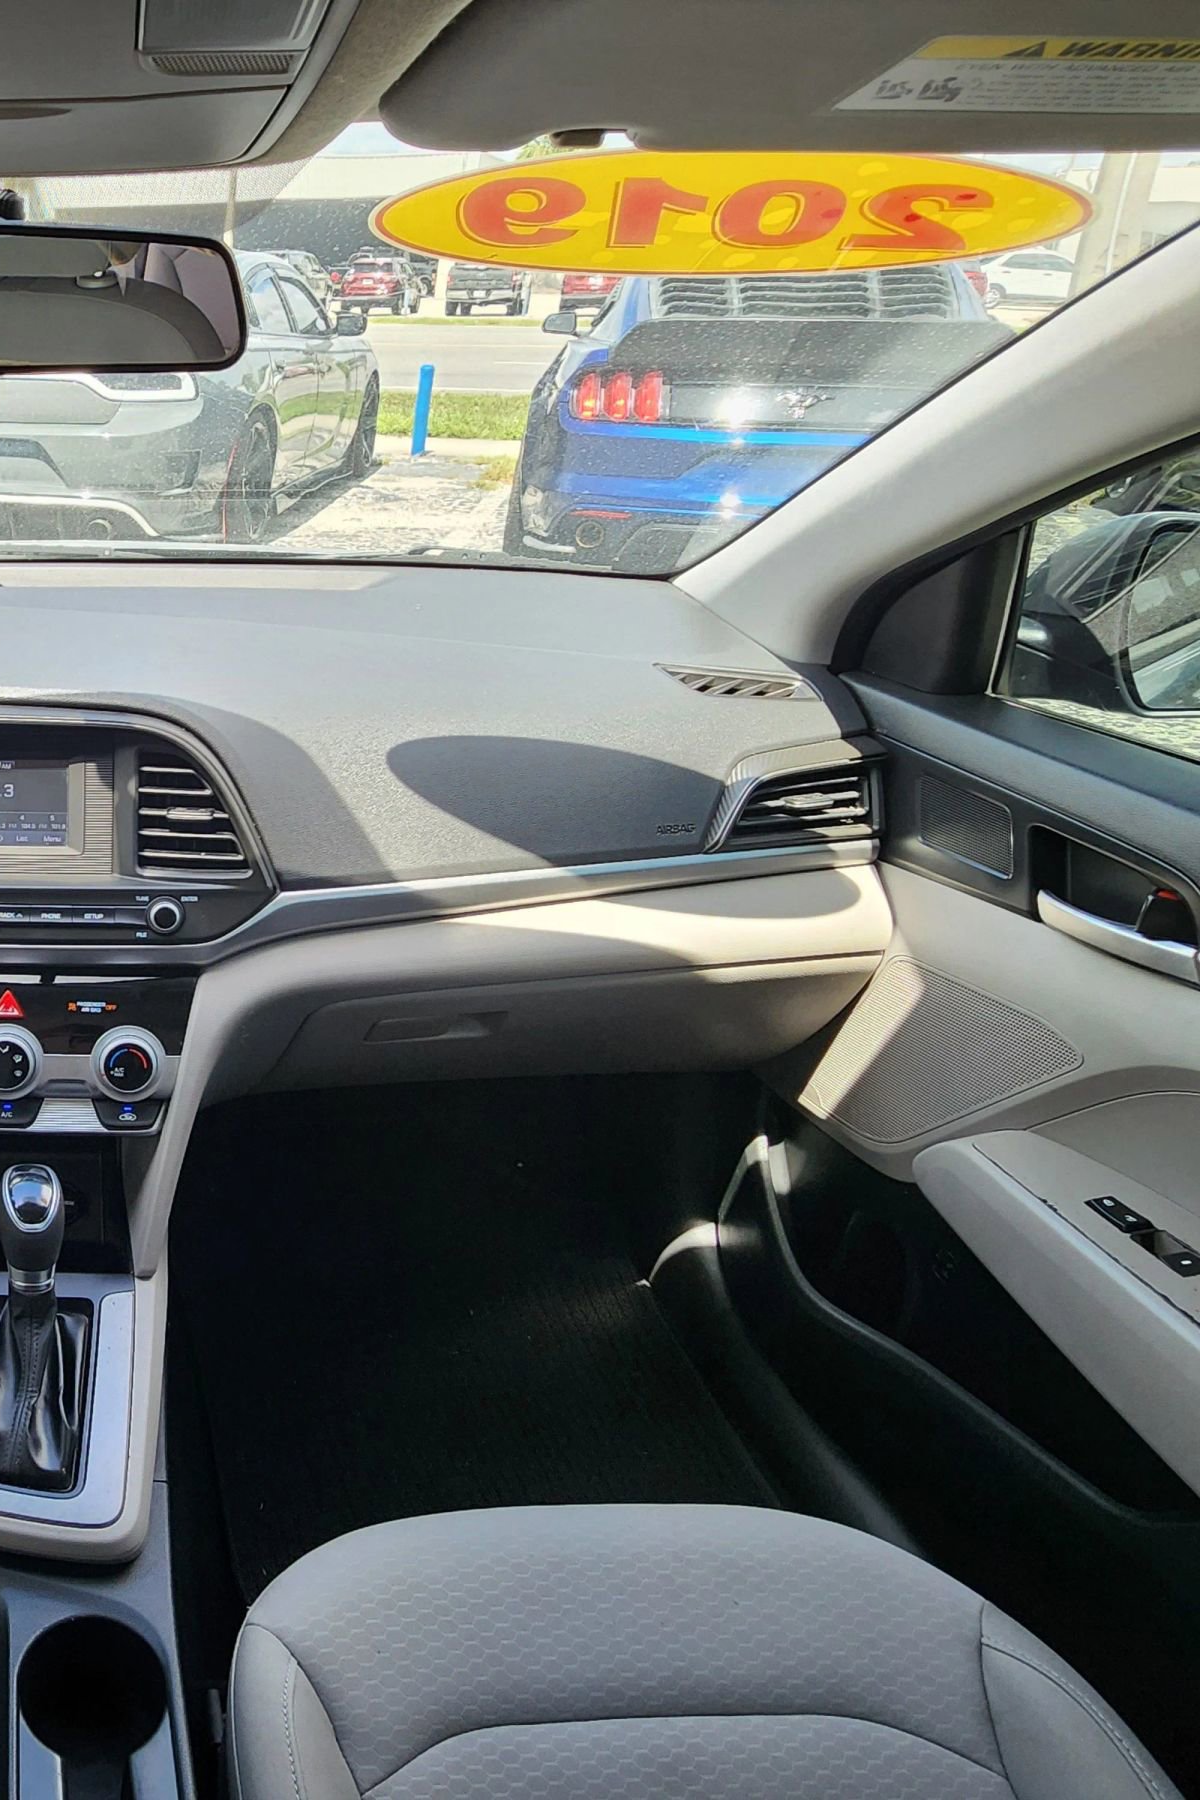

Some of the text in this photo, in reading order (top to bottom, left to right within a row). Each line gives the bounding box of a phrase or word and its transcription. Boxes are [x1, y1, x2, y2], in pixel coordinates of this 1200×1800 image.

[656, 823, 696, 834] AIRBAG
[43, 833, 63, 843] Menu
[83, 912, 105, 920] SETUP
